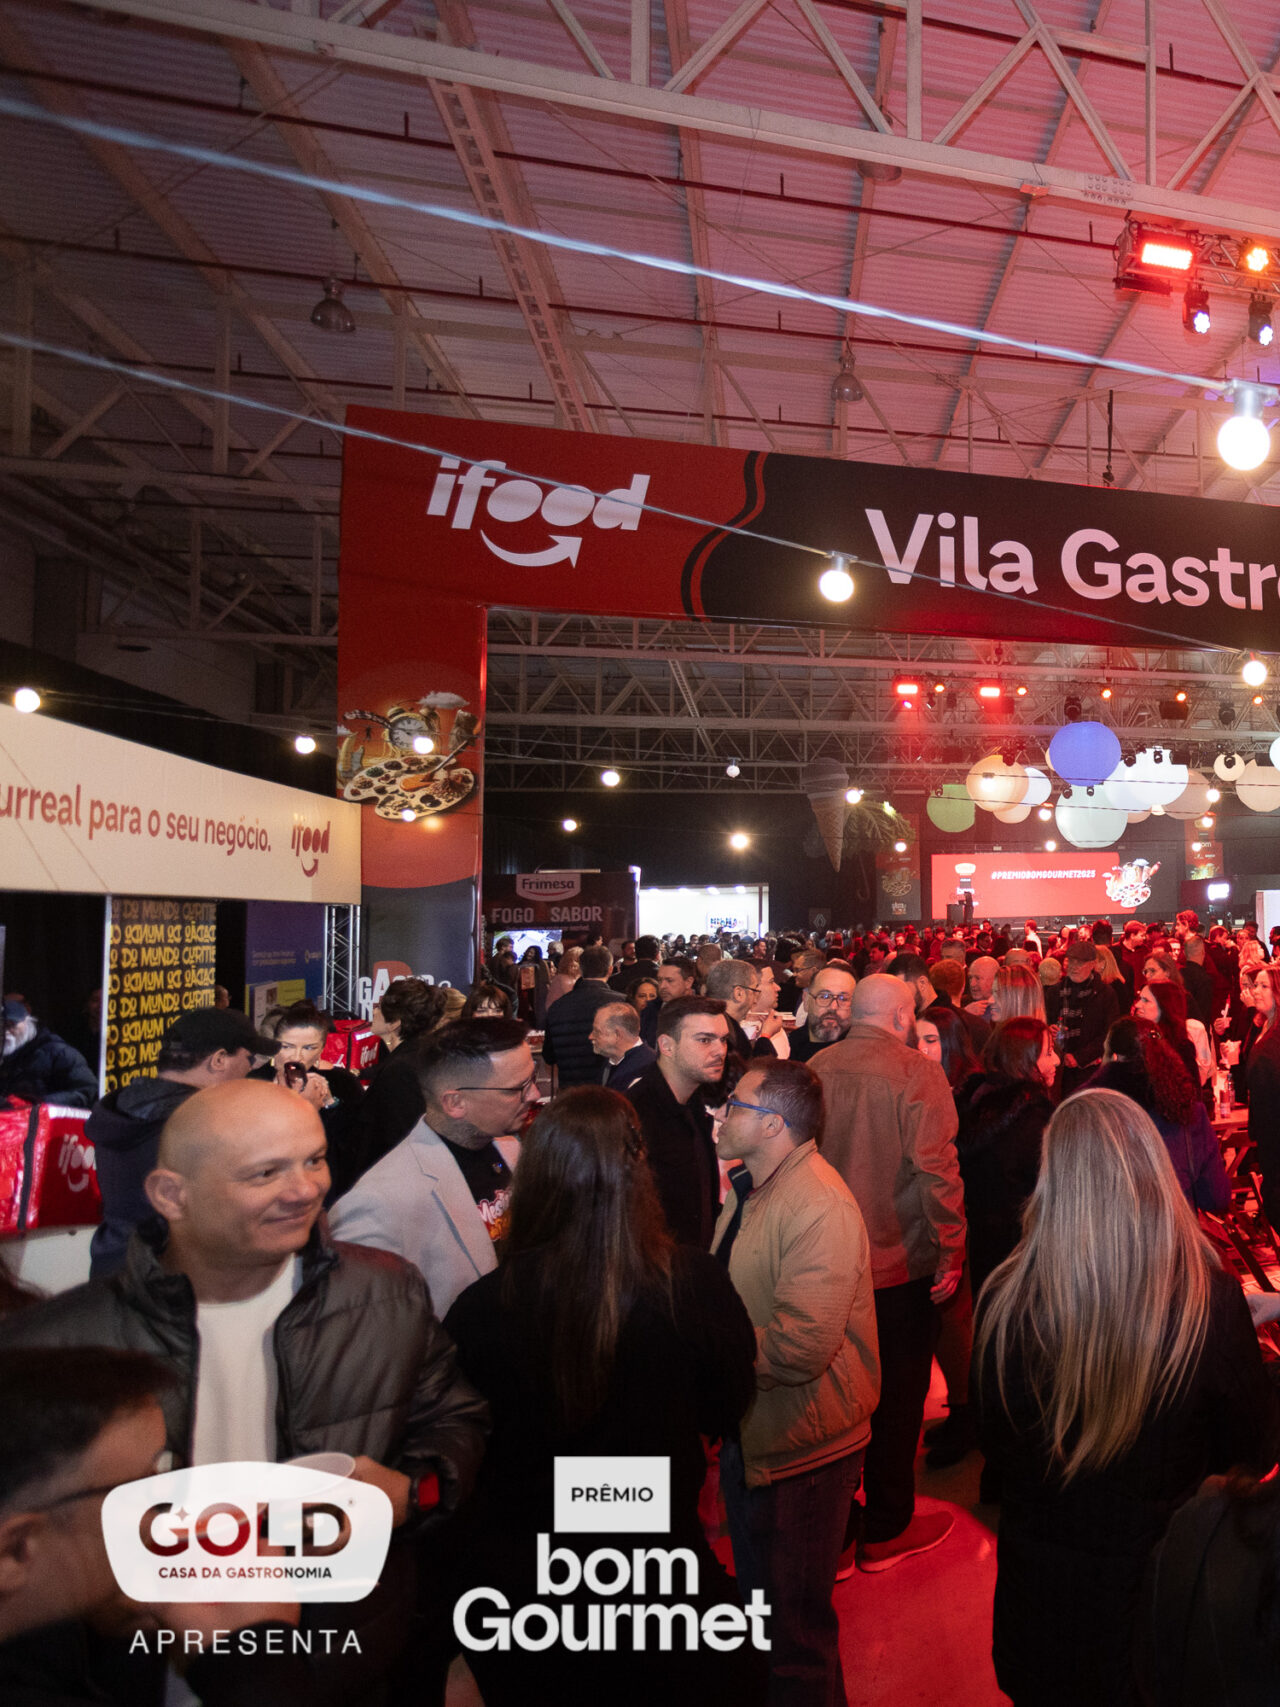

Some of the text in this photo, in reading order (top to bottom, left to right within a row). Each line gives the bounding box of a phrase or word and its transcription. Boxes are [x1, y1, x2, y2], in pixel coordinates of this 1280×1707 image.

[426, 455, 651, 531] ifood
[865, 508, 1039, 594] Vila
[89, 798, 141, 840] para
[148, 809, 161, 837] o
[166, 812, 199, 843] seu
[204, 815, 271, 856] negócio.
[522, 879, 575, 890] Frimesa
[492, 906, 603, 924] FOGO SABOR
[121, 948, 138, 968] DO
[141, 946, 180, 969] MUNDO
[120, 997, 137, 1018] DO
[139, 992, 180, 1015] MUNDO
[118, 1046, 136, 1067] DO
[58, 1133, 97, 1175] ifoo
